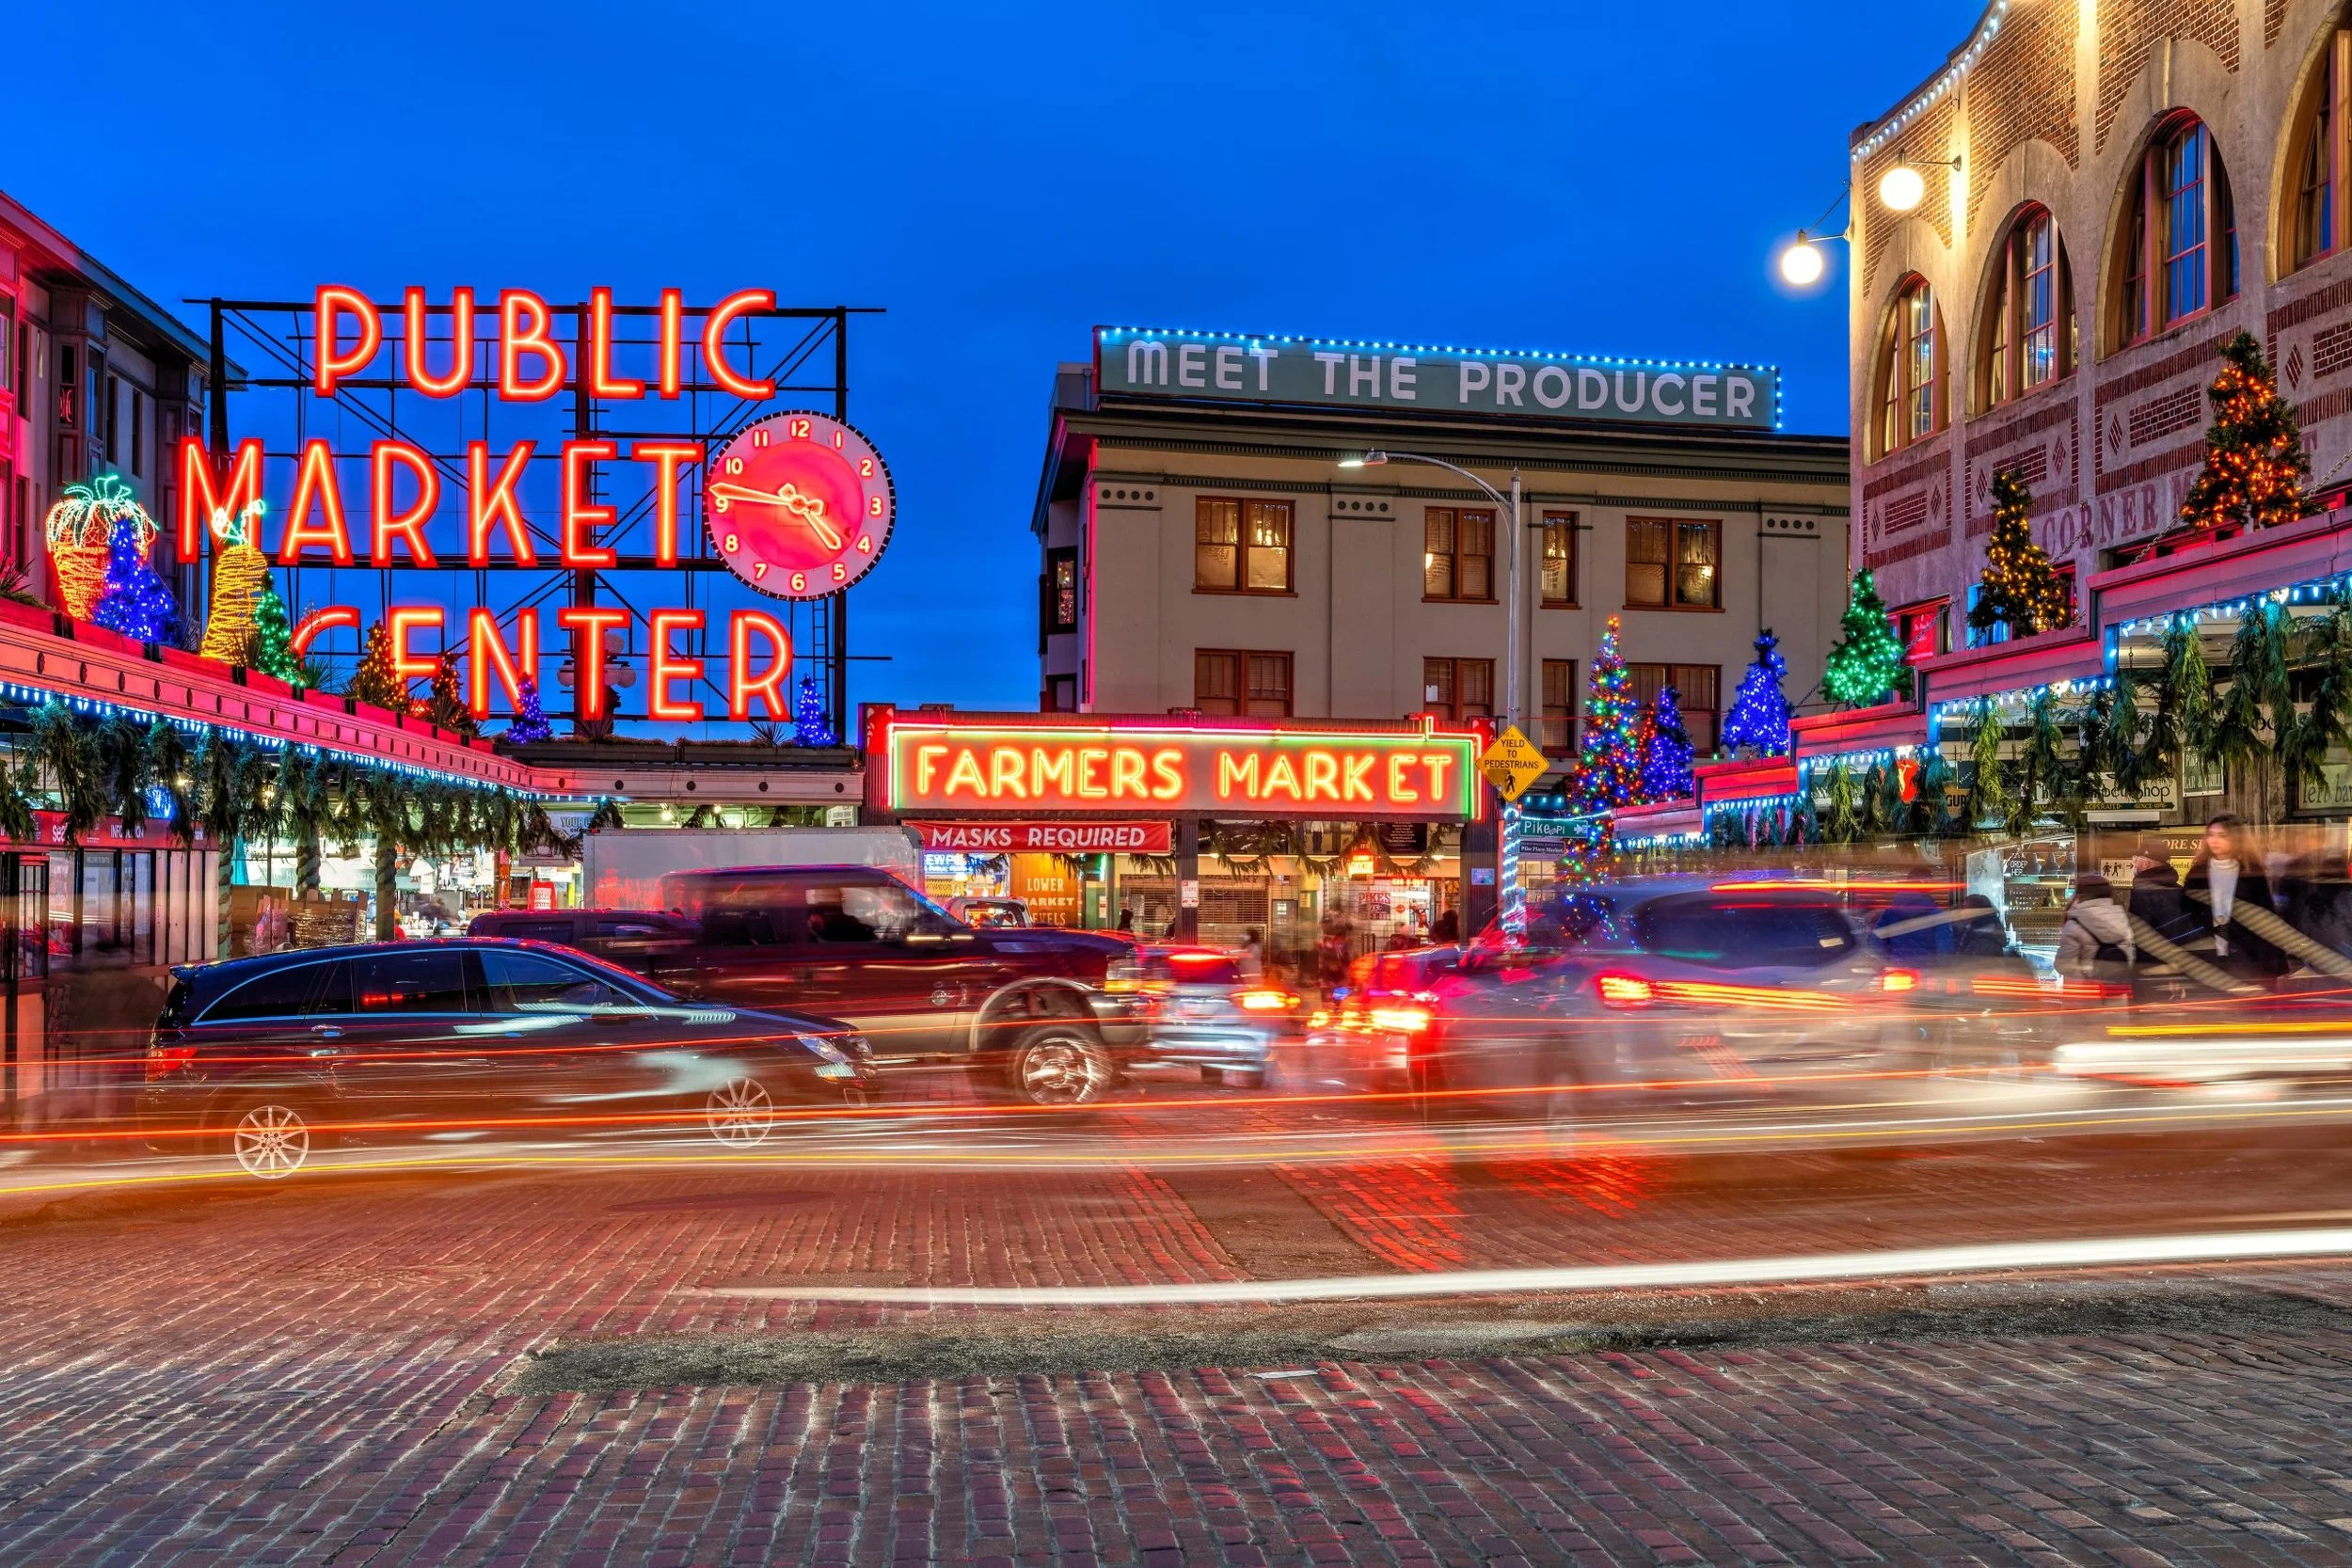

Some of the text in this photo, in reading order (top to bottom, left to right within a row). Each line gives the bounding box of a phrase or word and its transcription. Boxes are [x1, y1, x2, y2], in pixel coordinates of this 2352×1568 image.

[315, 285, 776, 402] PUBLIC
[1128, 340, 1756, 419] MEET THE PRODUCER
[791, 420, 810, 437] 12
[754, 432, 768, 447] 11
[835, 432, 842, 448] 1
[726, 458, 743, 474] 10
[861, 459, 873, 476] 2
[177, 436, 706, 568] MARKET
[715, 497, 729, 513] 9
[870, 498, 882, 515] 3
[2042, 483, 2158, 557] CORNER
[725, 535, 739, 551] 8
[857, 535, 871, 552] 4
[755, 563, 768, 578] 7
[833, 563, 845, 579] 5
[791, 574, 805, 591] 6
[292, 607, 792, 722] CENTER
[1501, 739, 1525, 748] YIELD
[1507, 750, 1518, 758] TO
[1485, 760, 1539, 768] PEDESTRIANS
[916, 746, 1454, 802] FARMERS MARKET
[1524, 821, 1565, 834] Pike Pl
[931, 828, 1145, 847] MASKS REQUIRED
[1027, 878, 1064, 891] LOWER
[1027, 897, 1074, 906] ARKET
[1032, 912, 1066, 925] EVELS
